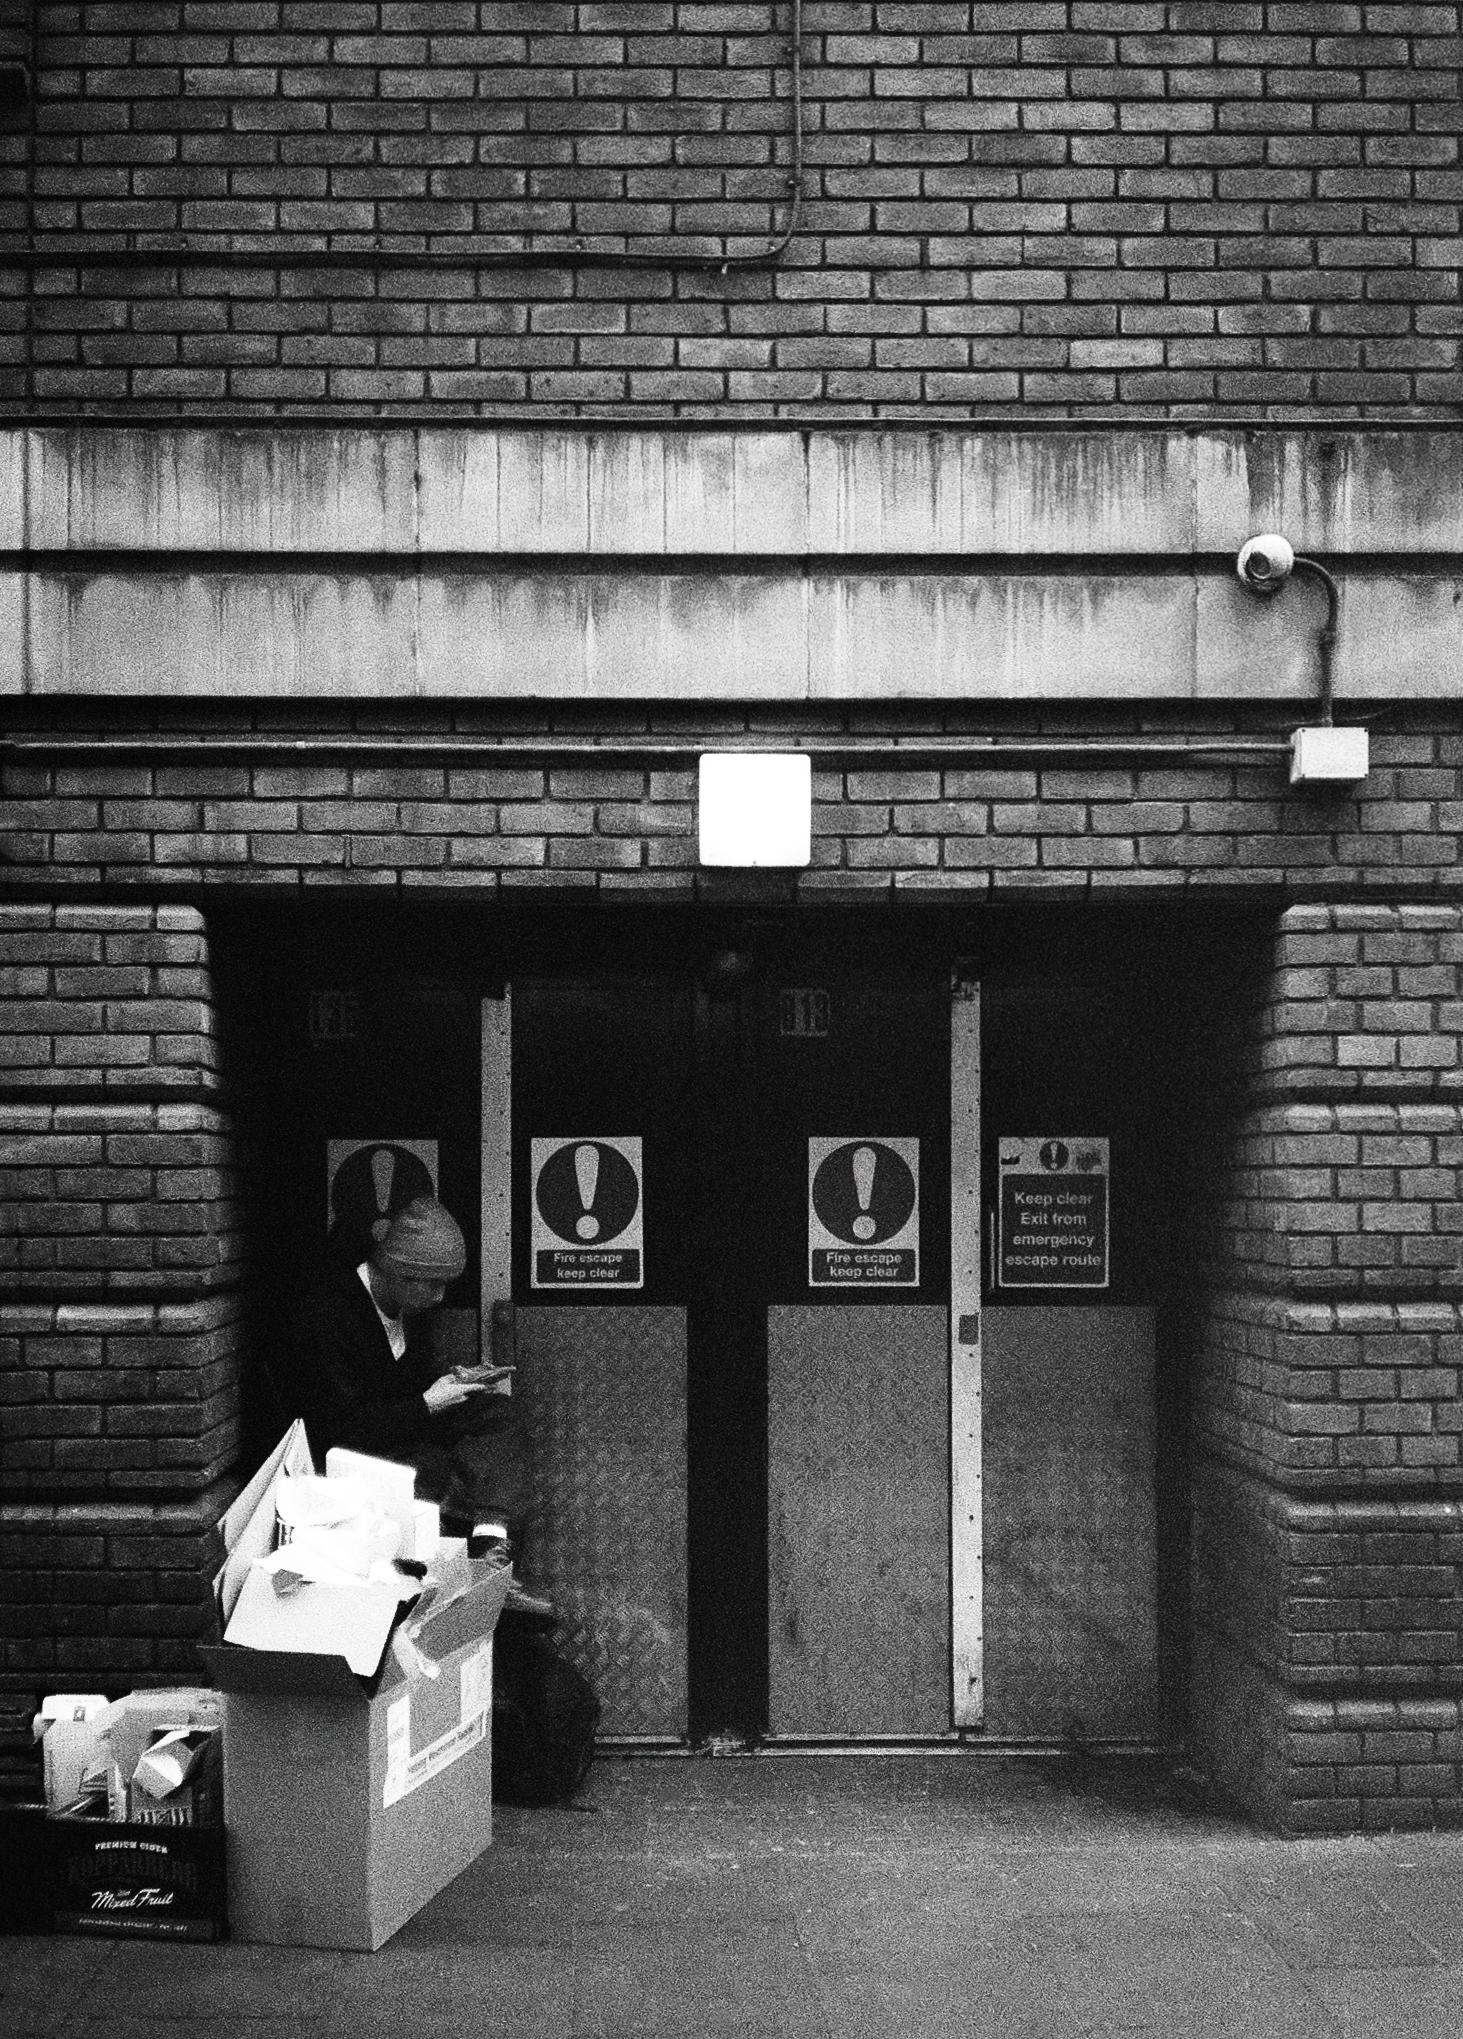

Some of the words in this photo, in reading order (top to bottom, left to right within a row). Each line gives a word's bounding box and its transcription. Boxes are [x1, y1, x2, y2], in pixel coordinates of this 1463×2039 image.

[1014, 1191, 1052, 1206] Keep
[1056, 1192, 1093, 1205] clear
[1020, 1212, 1049, 1225] Exit
[1052, 1212, 1087, 1225] from
[1012, 1234, 1095, 1248] emergency
[553, 1252, 576, 1263] Fire
[579, 1253, 623, 1264] escape
[826, 1251, 851, 1263] Fire
[854, 1253, 902, 1265] escape
[1004, 1254, 1058, 1268] escape
[1062, 1254, 1101, 1266] route
[557, 1267, 586, 1280] keep
[589, 1267, 620, 1279] clear
[829, 1266, 862, 1279] keep
[866, 1266, 899, 1277] clear
[91, 1890, 139, 1909] Mixed
[136, 1887, 174, 1908] Fruit
